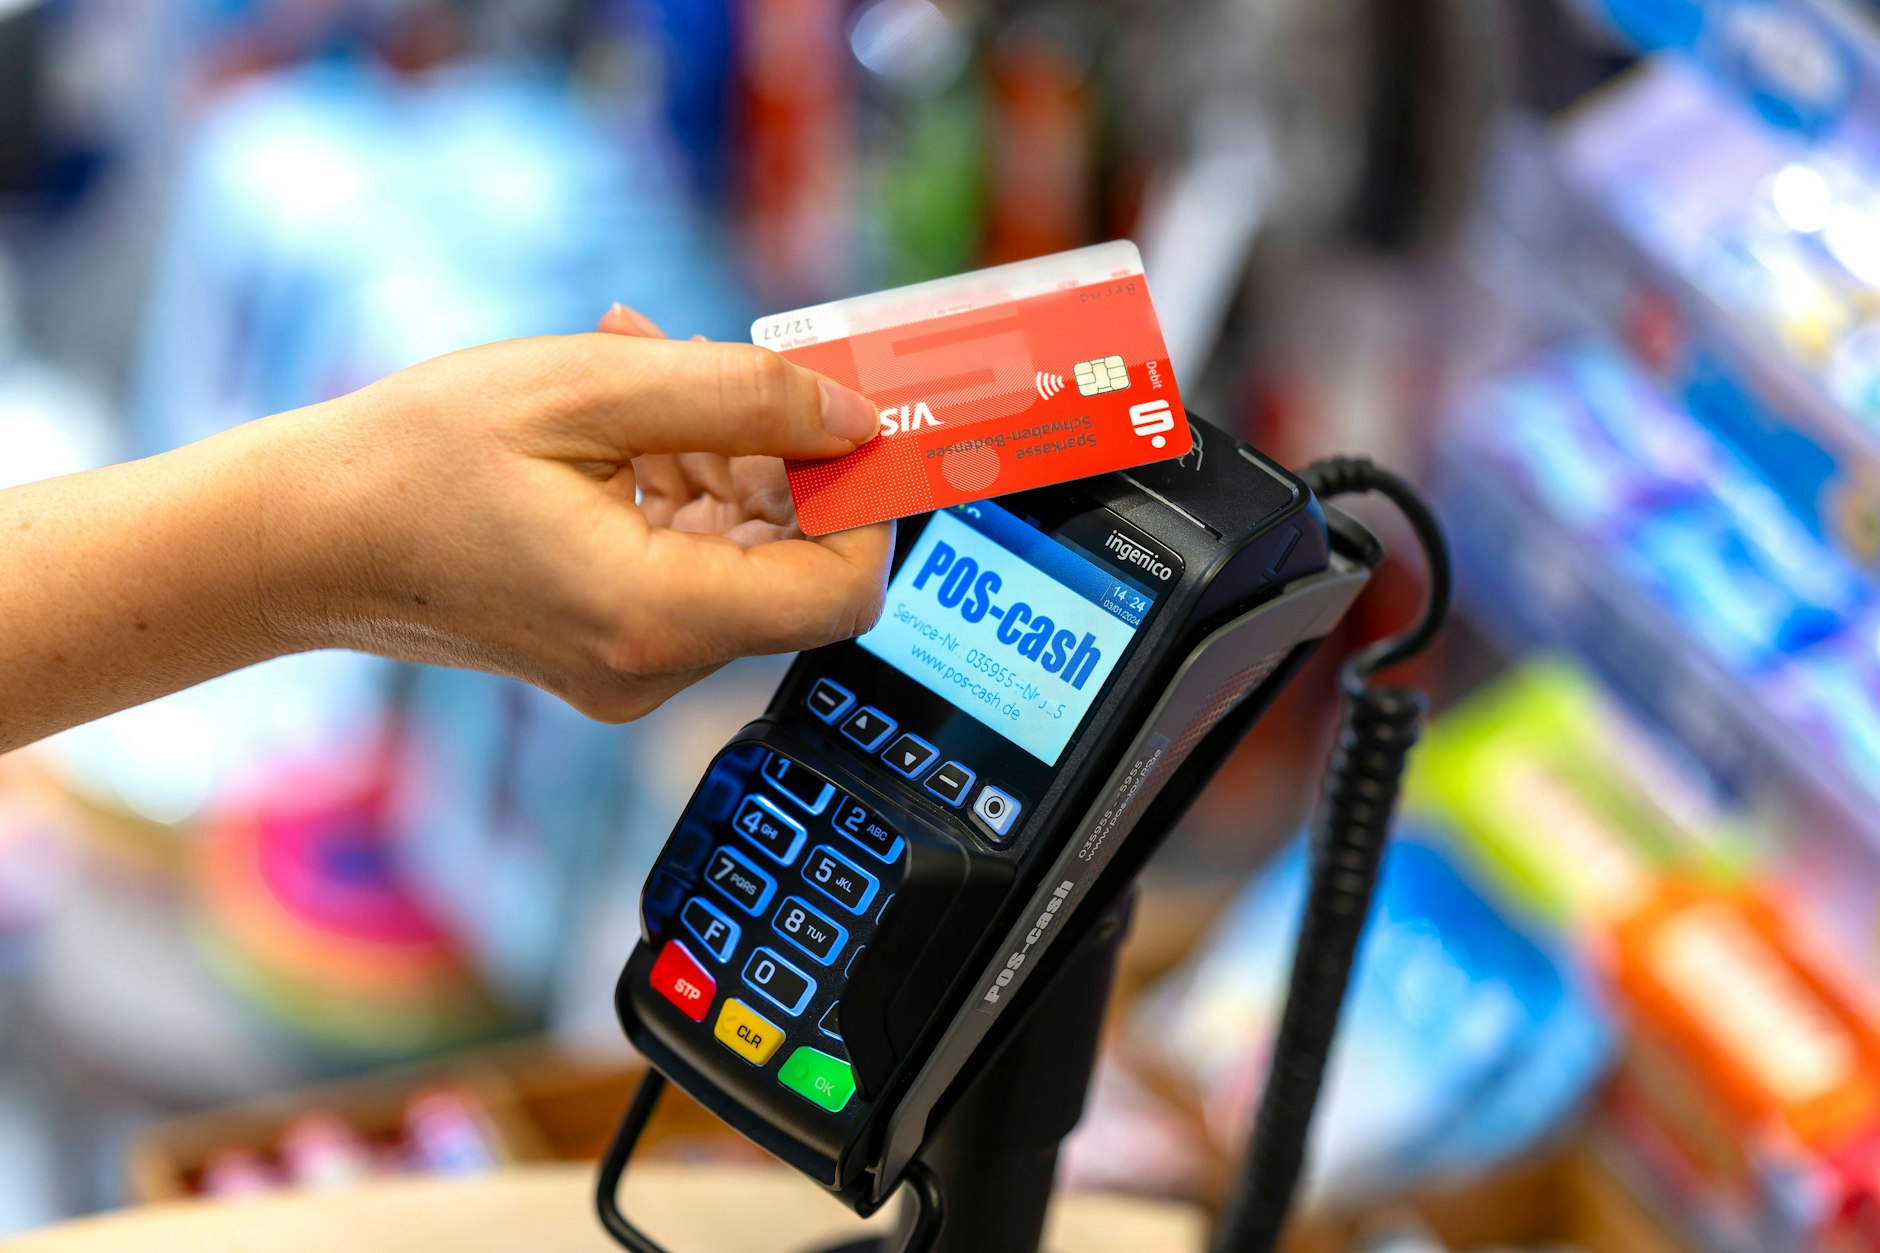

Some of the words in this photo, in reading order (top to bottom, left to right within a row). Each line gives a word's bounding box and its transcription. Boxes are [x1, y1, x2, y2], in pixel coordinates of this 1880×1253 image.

[1080, 283, 1136, 304] Bernd
[764, 318, 813, 340] 12/27
[1146, 360, 1163, 390] Debit
[880, 402, 944, 437] VIS
[926, 415, 1093, 460] Schwaben-Bodensee
[1015, 433, 1097, 460] Sparkasse
[1105, 530, 1172, 582] ingenico
[911, 540, 1102, 691] POS-cash
[1103, 599, 1142, 627] 03/01/2024
[911, 644, 1021, 721] www.pos-cash.de
[776, 757, 792, 780] 1
[742, 810, 764, 834] 4
[760, 823, 778, 840] GHI
[844, 806, 867, 833] 2
[866, 823, 888, 842] ABC
[713, 857, 735, 881] 7
[730, 872, 757, 896] PQRS
[815, 857, 837, 883] 5
[835, 876, 852, 893] JKL
[703, 919, 726, 943] F
[784, 908, 806, 933] 8
[806, 923, 827, 944] TUV
[984, 880, 1075, 1004] POS-cash
[754, 958, 776, 985] 0
[674, 977, 701, 1001] STP
[736, 1024, 762, 1050] CLR
[814, 1076, 836, 1097] OK
